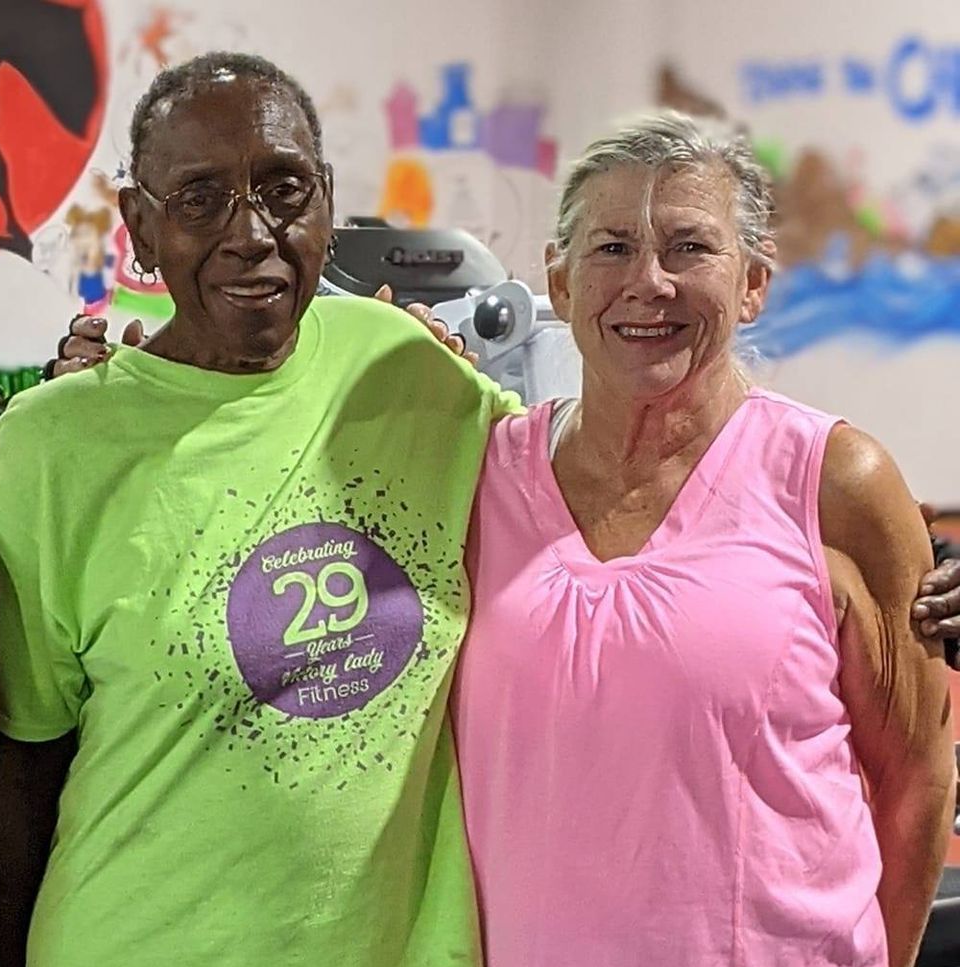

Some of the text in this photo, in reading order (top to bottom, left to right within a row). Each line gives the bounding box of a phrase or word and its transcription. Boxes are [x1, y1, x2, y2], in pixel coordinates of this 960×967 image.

[261, 539, 358, 573] Celebrating
[272, 561, 369, 646] 29
[306, 633, 353, 657] Years
[344, 648, 384, 674] lady
[297, 678, 370, 706] Fitness
